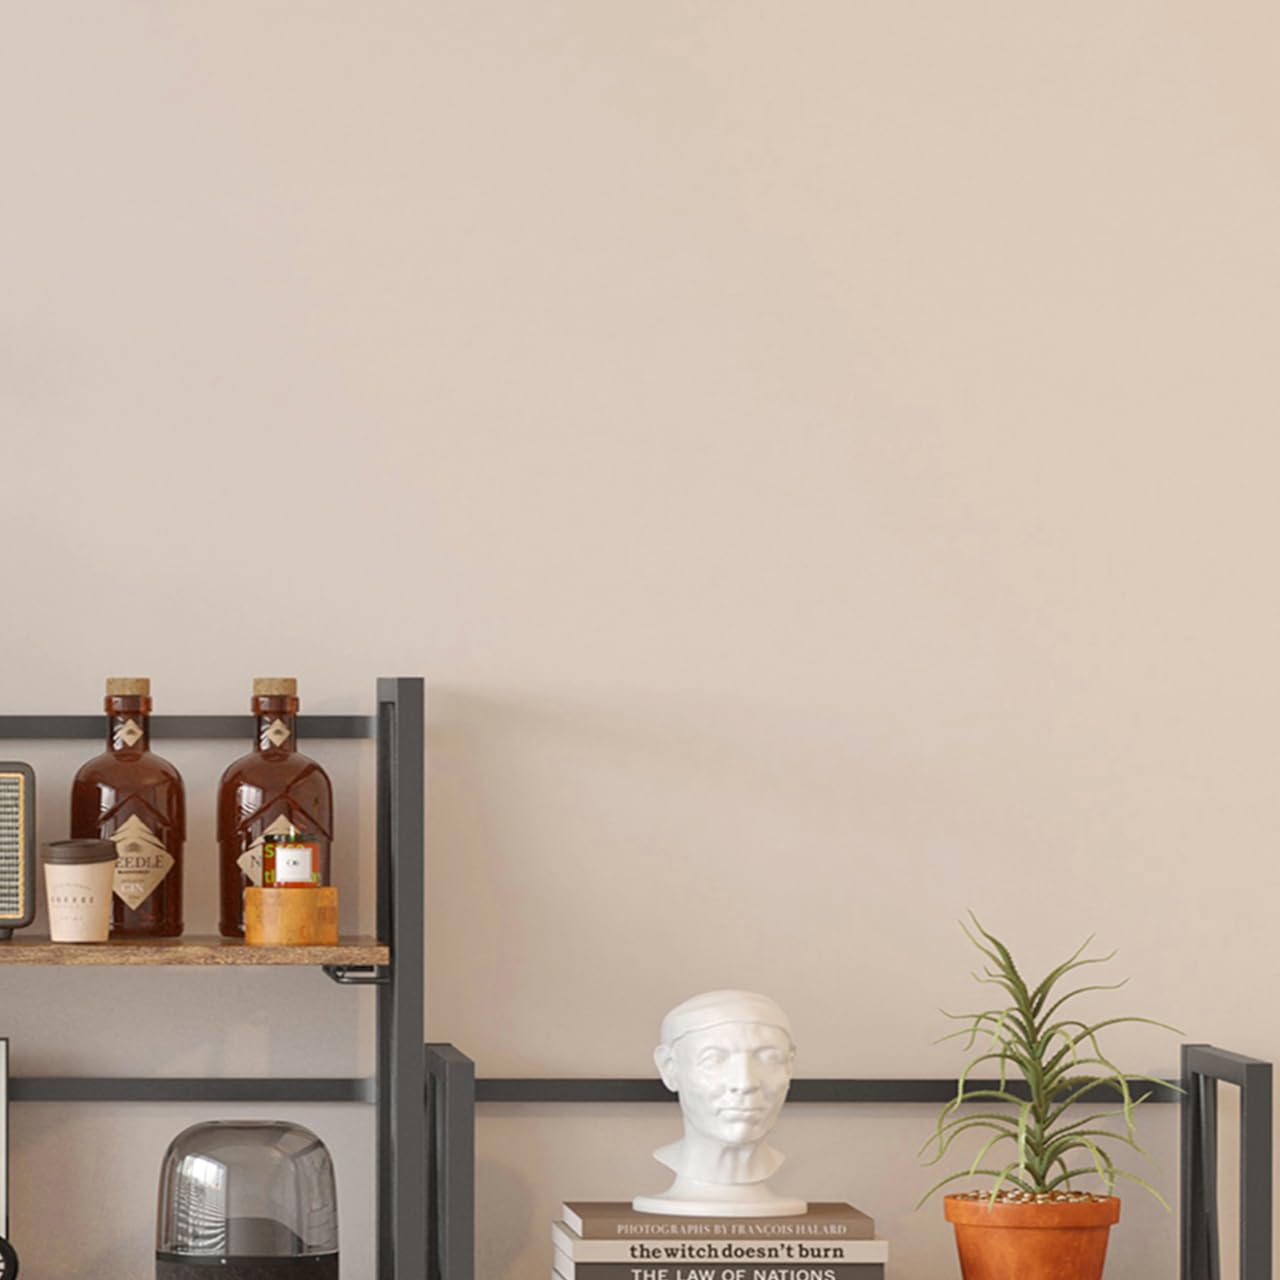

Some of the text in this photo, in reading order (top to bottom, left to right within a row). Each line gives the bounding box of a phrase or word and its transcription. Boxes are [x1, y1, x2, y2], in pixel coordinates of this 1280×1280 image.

[115, 855, 164, 869] EEDLE
[617, 1223, 711, 1235] PHOTOGRAPHS
[713, 1223, 730, 1235] BY
[795, 1223, 848, 1235] HALARD
[630, 1243, 845, 1260] the witch doesn't burn
